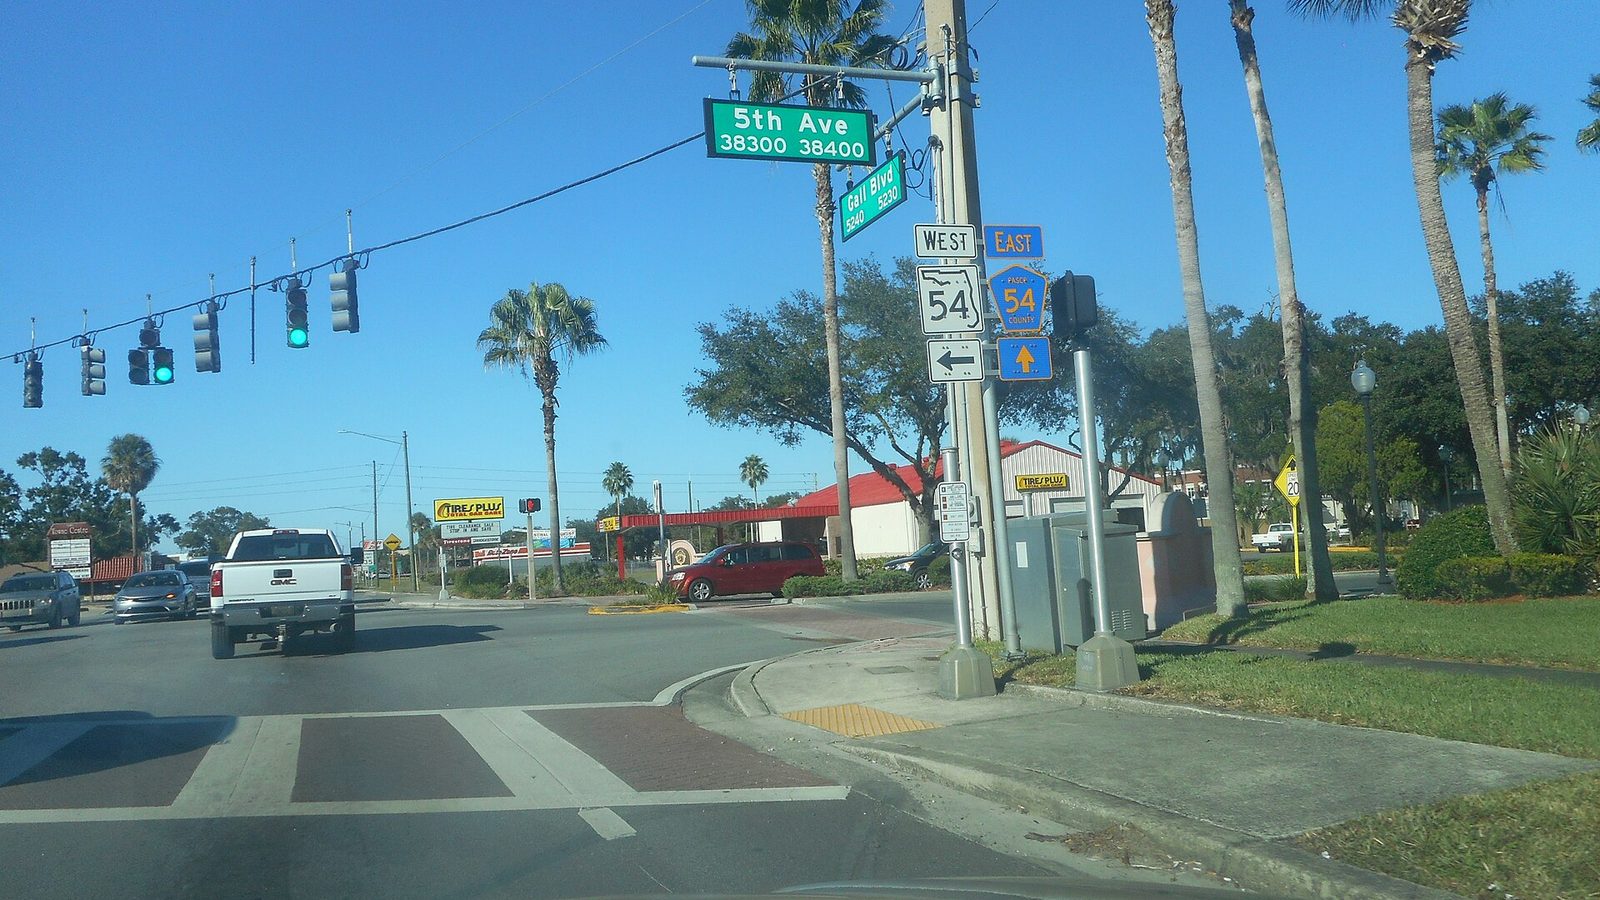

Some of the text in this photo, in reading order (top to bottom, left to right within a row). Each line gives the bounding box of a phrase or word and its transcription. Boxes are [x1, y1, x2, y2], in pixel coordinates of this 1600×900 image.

[734, 107, 849, 135] 5th Ave
[720, 134, 865, 159] 38300 38400
[847, 165, 894, 212] Gall Blvd
[845, 187, 898, 233] 5240 5230
[923, 230, 967, 251] WEST
[994, 231, 1032, 253] EAST
[928, 290, 969, 322] 54
[1003, 288, 1036, 315] 54
[1008, 315, 1036, 324] COUNTY
[1023, 476, 1063, 486] TIRES PLUS
[1287, 481, 1300, 496] 20
[445, 502, 502, 513] TIRES PLUS
[270, 578, 297, 586] GMC
